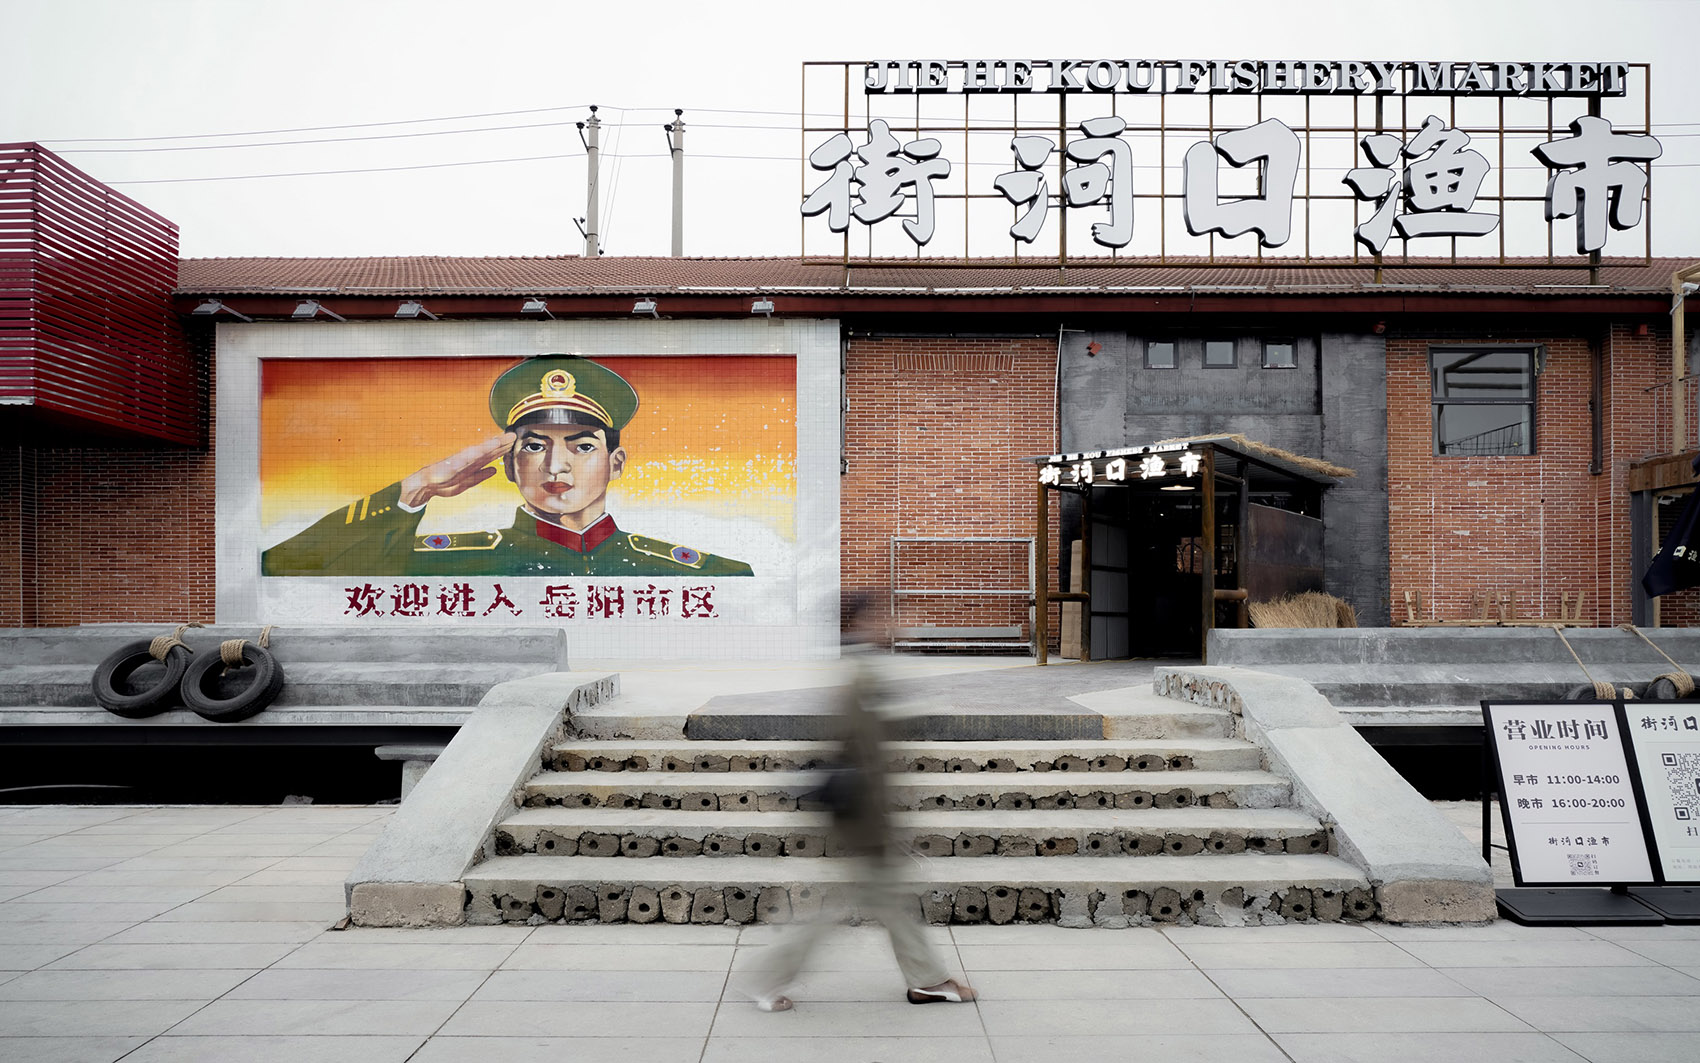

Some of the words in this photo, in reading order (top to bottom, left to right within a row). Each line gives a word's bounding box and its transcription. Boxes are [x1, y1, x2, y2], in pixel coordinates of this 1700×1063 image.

[865, 60, 948, 92] JIE
[963, 60, 1034, 92] HE
[1047, 59, 1157, 92] KOU
[1176, 60, 1400, 93] FISHERY
[1414, 61, 1629, 94] MARKET
[801, 114, 1662, 255] 街河口渔市
[1083, 451, 1101, 459] KOU
[1038, 452, 1202, 486] 街河口渔市
[1502, 719, 1609, 741] 营业时间
[1641, 715, 1698, 731] 街河口
[1513, 774, 1538, 786] 早市
[1547, 775, 1620, 785] 11:00-14:00
[1517, 798, 1543, 810] 晚市
[1552, 798, 1625, 808] 16:00-20:00
[1548, 836, 1610, 847] 街河口渔市
